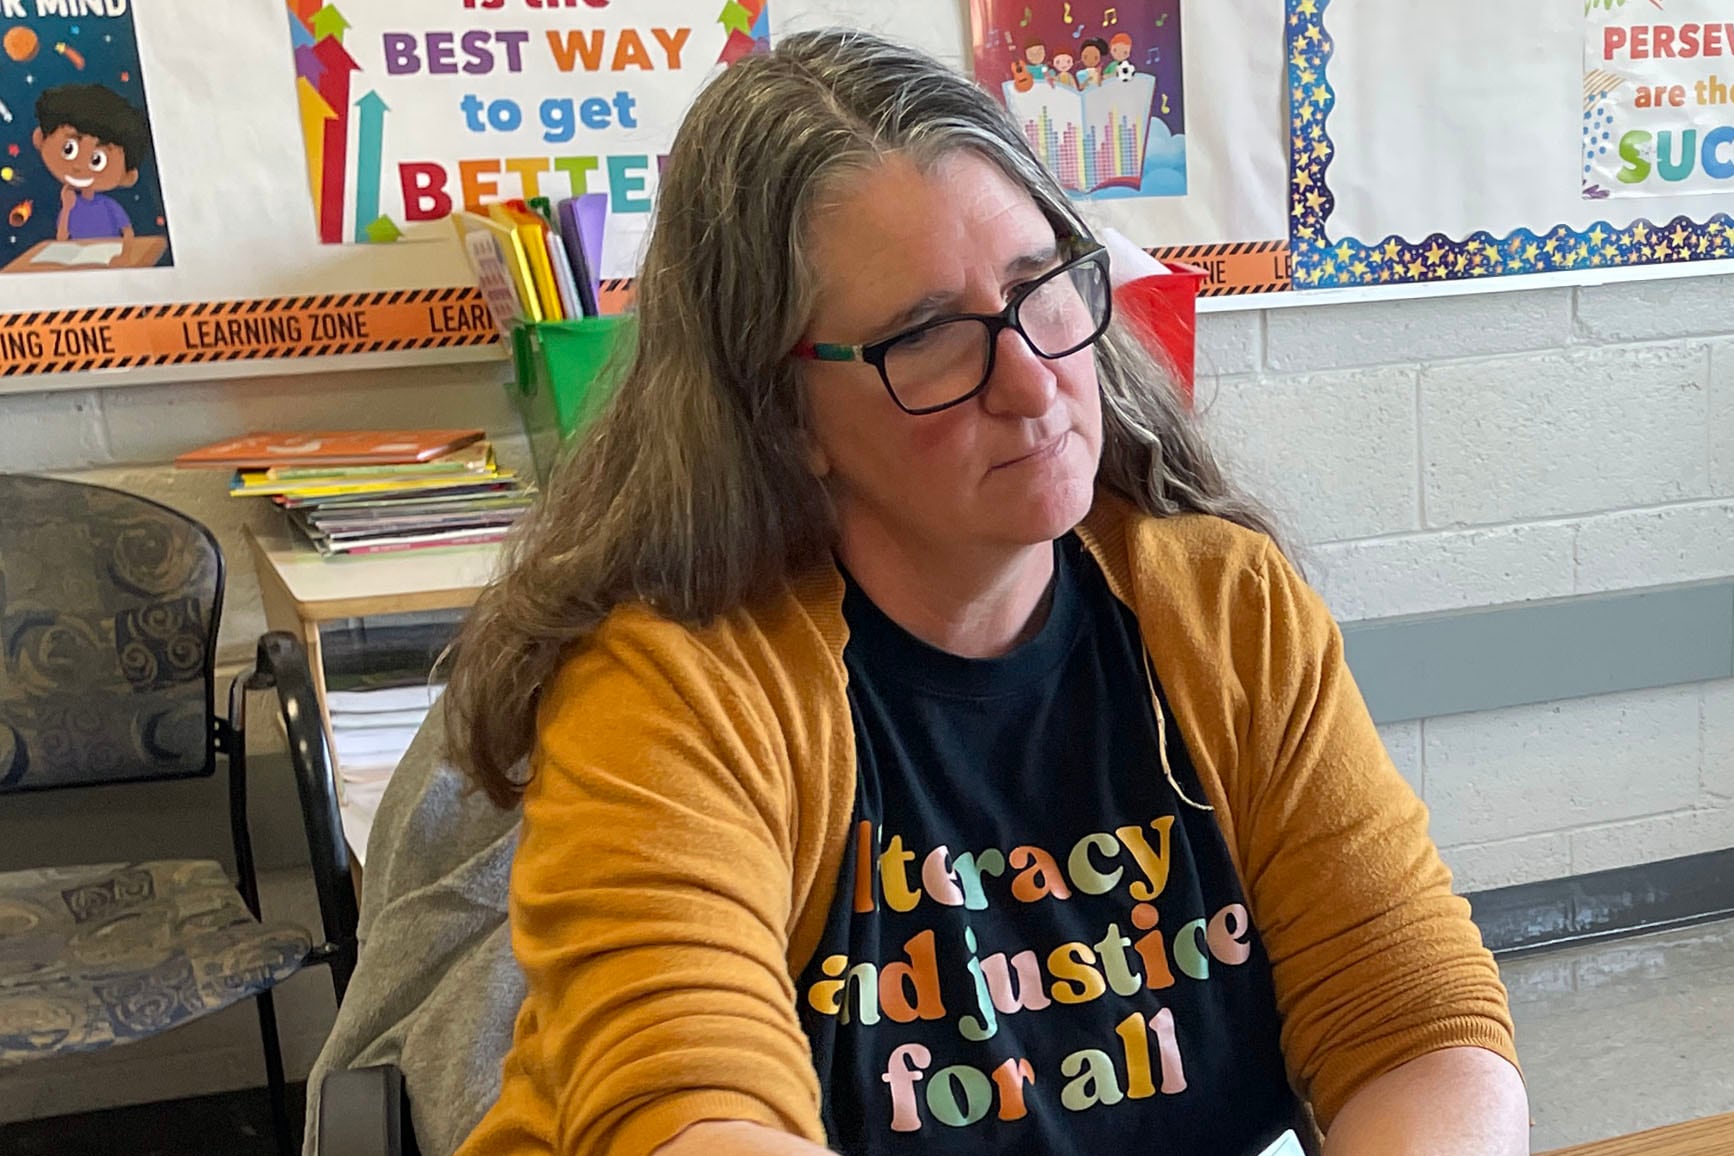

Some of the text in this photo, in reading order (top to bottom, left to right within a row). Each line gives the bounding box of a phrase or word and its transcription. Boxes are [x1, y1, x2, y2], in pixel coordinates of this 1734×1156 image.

[383, 28, 691, 75] BEST WAY
[460, 91, 637, 143] to get
[1634, 81, 1686, 109] are
[398, 154, 675, 222] BETTE
[50, 325, 115, 357] ZONE
[182, 315, 301, 350] LEARNING
[302, 311, 370, 343] ZONE
[853, 815, 1175, 912] lteracy
[807, 903, 1251, 1042] and justice
[881, 1007, 1187, 1132] for all
